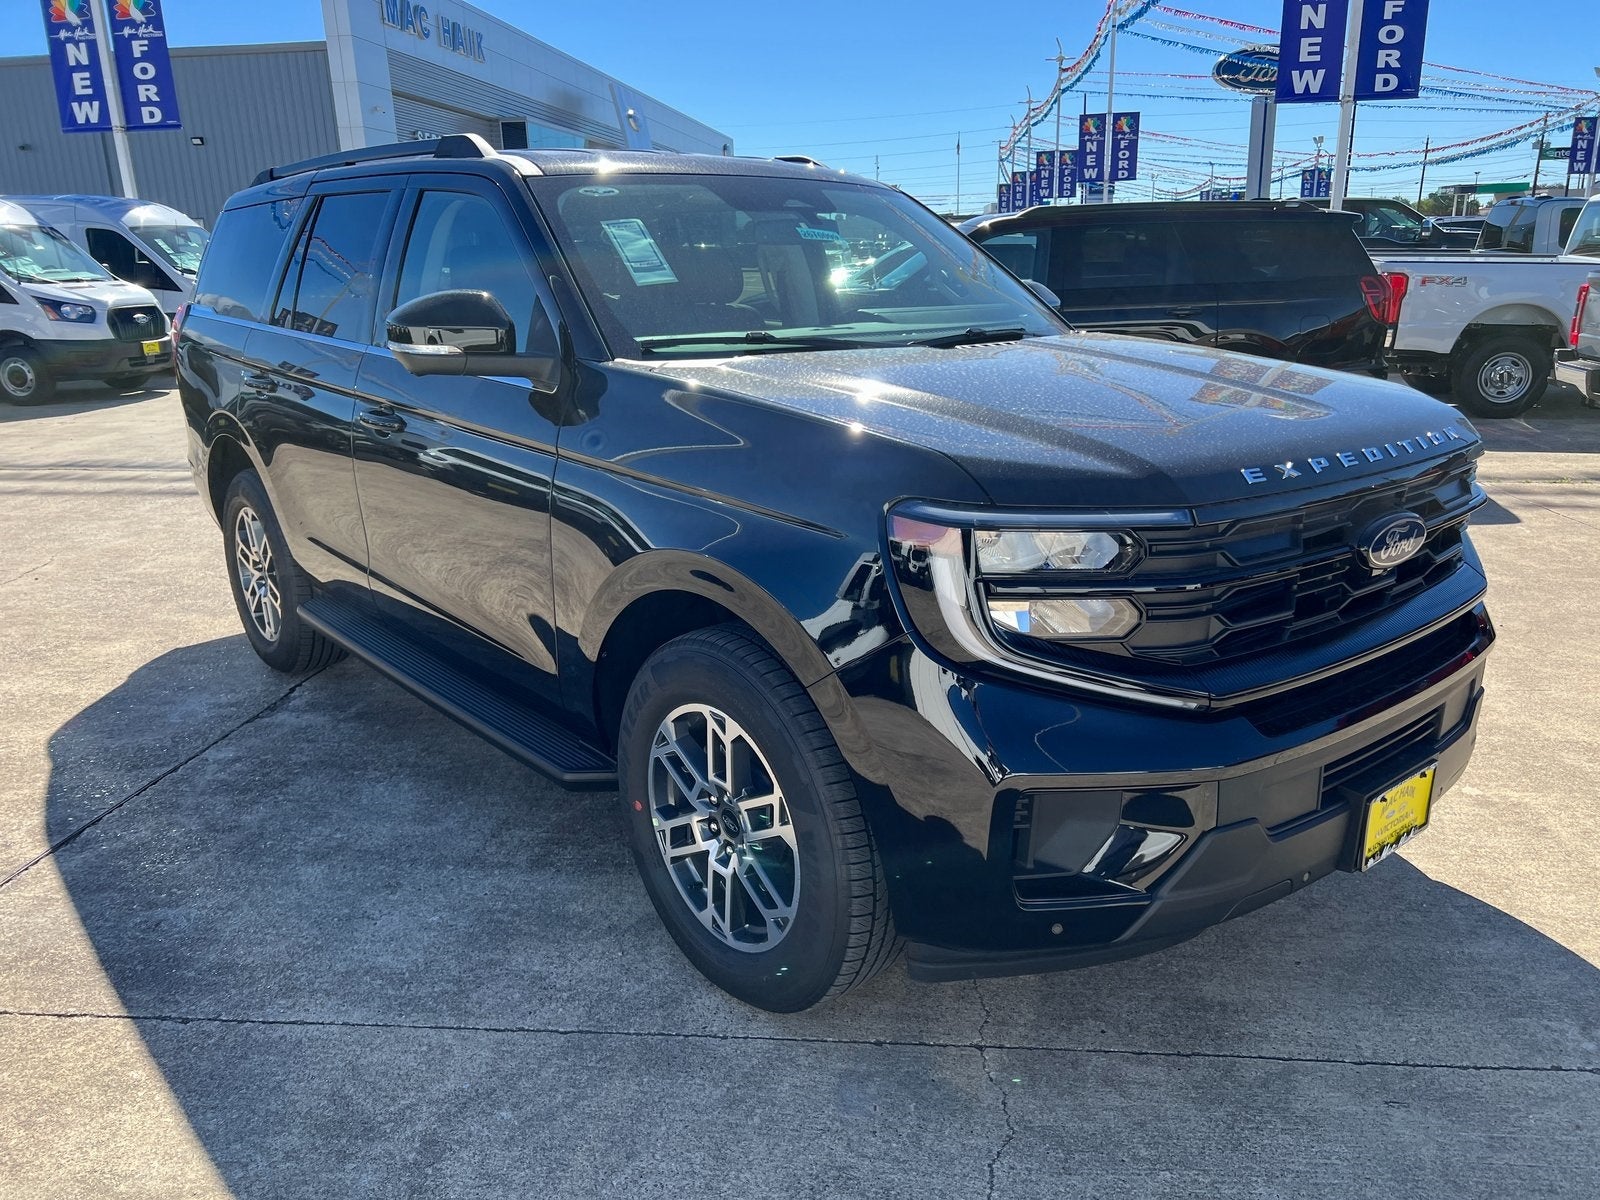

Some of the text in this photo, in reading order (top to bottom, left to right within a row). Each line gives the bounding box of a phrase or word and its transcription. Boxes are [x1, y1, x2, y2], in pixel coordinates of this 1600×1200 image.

[383, 0, 486, 62] MAC HAIK
[1291, 3, 1327, 94] NEW
[1374, 1, 1406, 92] FORD
[66, 42, 100, 124] NEW
[131, 40, 163, 124] FORD
[1083, 141, 1098, 179] NEW
[1118, 140, 1130, 179] FORD
[1573, 140, 1587, 171] NEW
[1015, 186, 1024, 207] NEW
[1039, 170, 1049, 197] NEW
[1063, 169, 1072, 196] FORD
[1420, 275, 1468, 287] FX4
[1240, 426, 1460, 485] EXPEDITION
[1380, 525, 1418, 560] Ford
